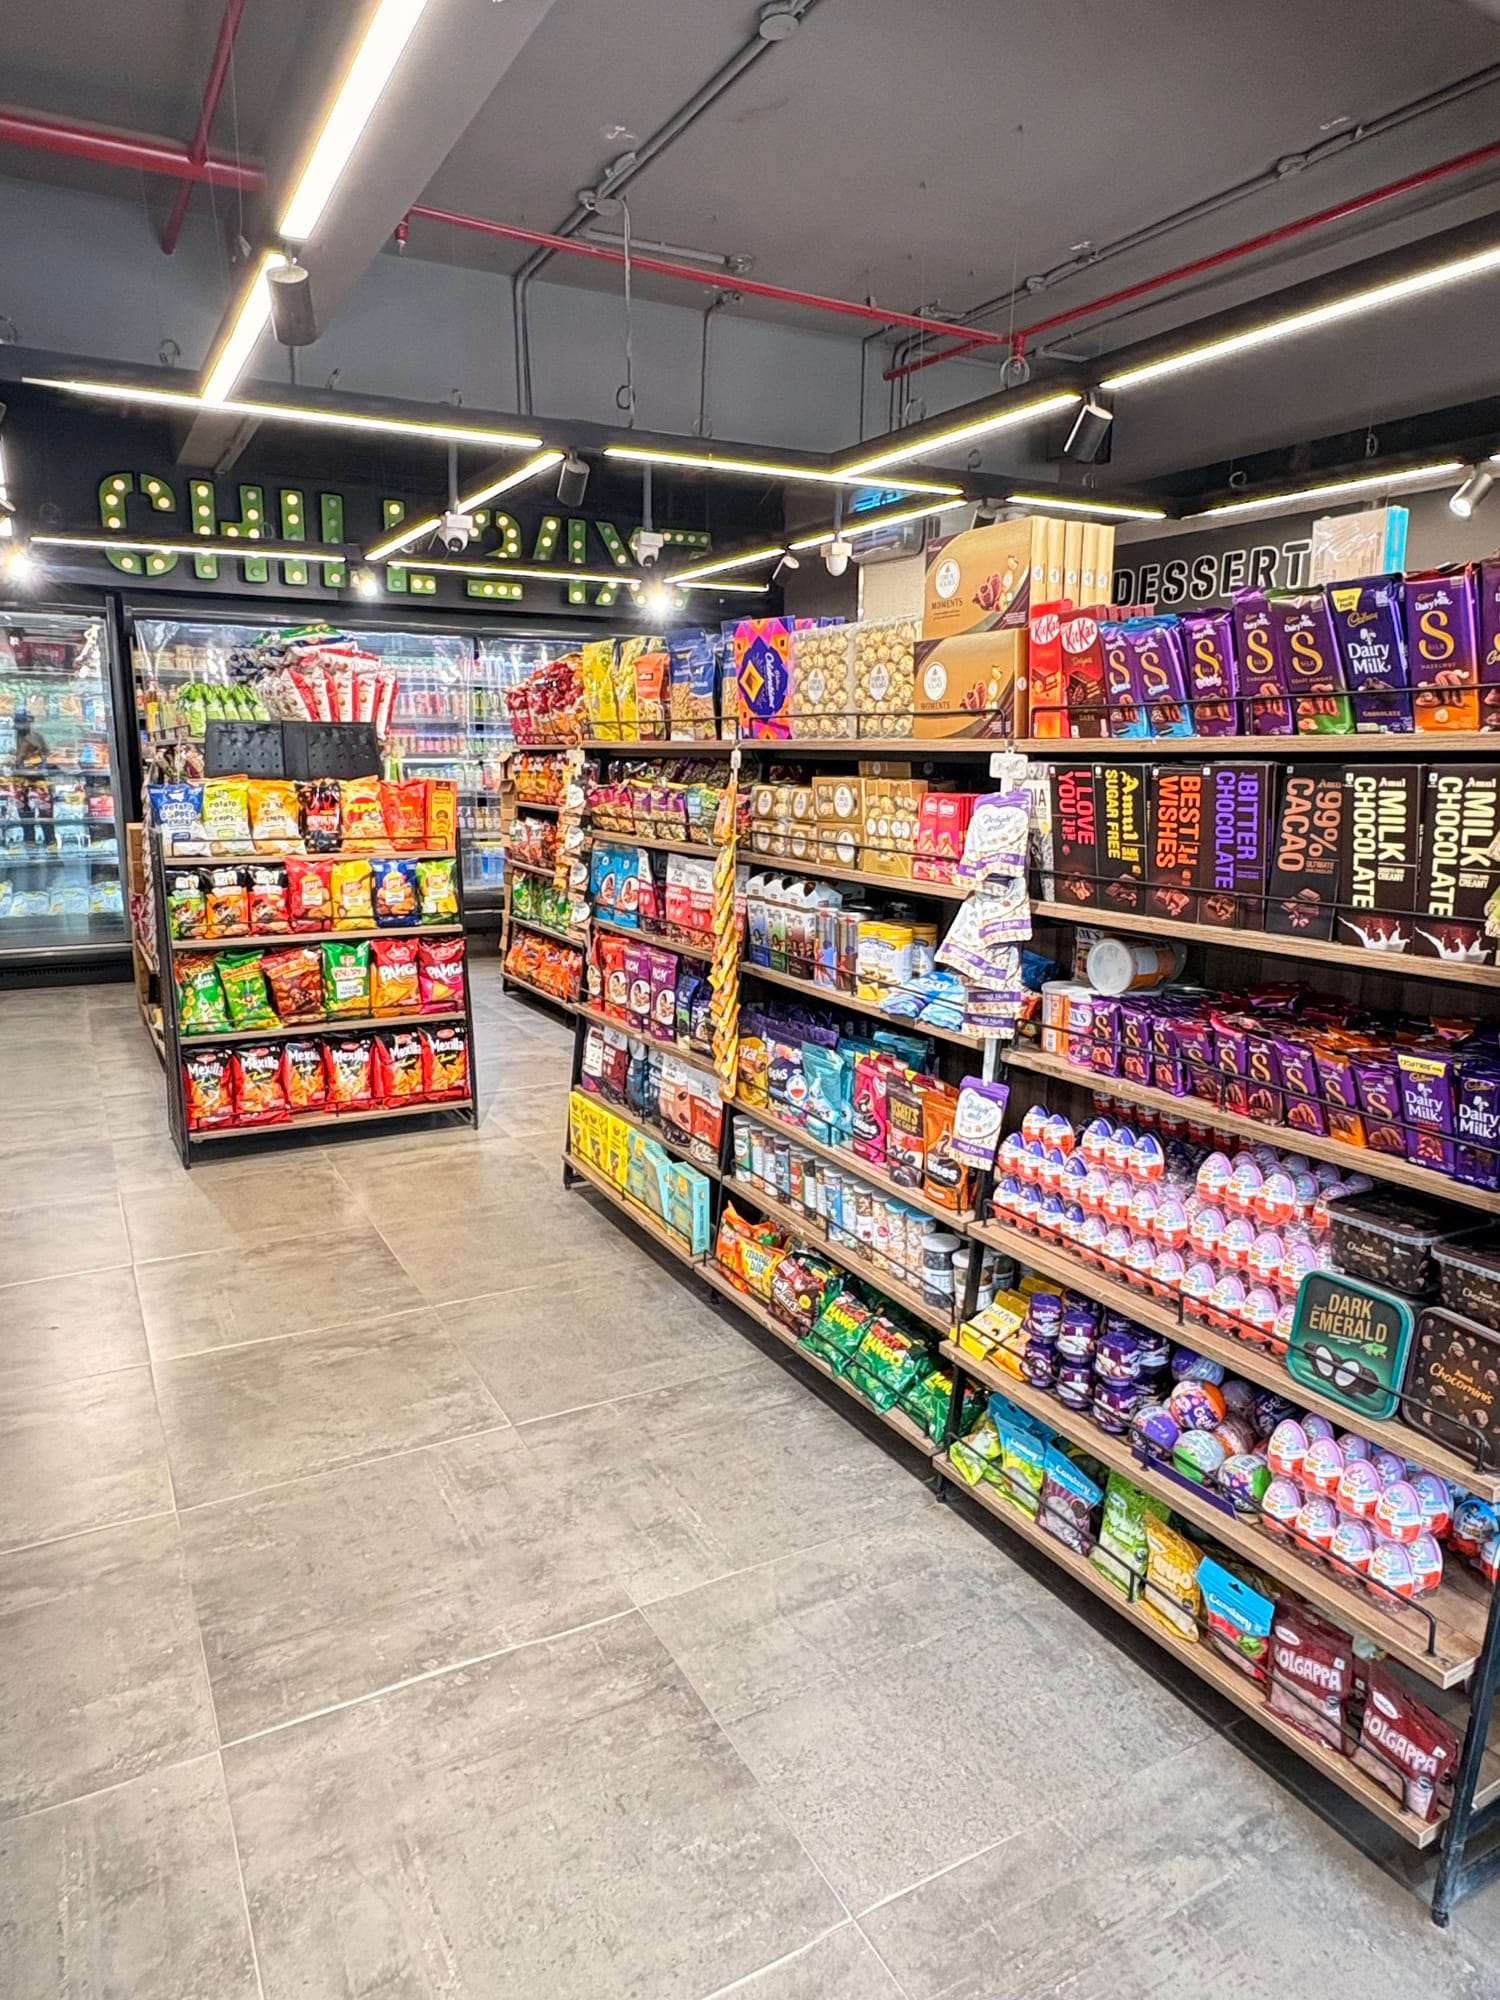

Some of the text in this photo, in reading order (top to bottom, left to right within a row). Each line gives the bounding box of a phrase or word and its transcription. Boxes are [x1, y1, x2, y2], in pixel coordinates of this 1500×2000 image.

[1113, 539, 1312, 606] DESSERT
[931, 598, 963, 609] MOMENTS
[1415, 602, 1433, 611] Dairy
[1063, 619, 1096, 651] KitKat
[1347, 643, 1390, 660] Dairy
[1353, 659, 1391, 675] Milk
[921, 701, 950, 710] MOMENTS
[1058, 771, 1077, 814] YOU
[1378, 777, 1406, 788] Amul
[1466, 777, 1496, 788] Amul
[164, 803, 194, 811] POTATO
[1076, 787, 1095, 845] LOVE
[1105, 769, 1121, 859] SUGAR FREE
[1120, 770, 1140, 840] Amul
[1179, 776, 1201, 840] BEST
[1156, 775, 1179, 868] WISHES
[1215, 771, 1236, 889] CHOCOLATE
[1237, 781, 1258, 860] BITTER
[1277, 777, 1315, 871] CACAO
[1308, 791, 1342, 857] 99%
[1378, 790, 1407, 861] MILK
[1459, 791, 1497, 868] MILK
[1352, 776, 1377, 908] CHOCOLATE
[1428, 776, 1463, 917] CHOCOLATE
[1459, 879, 1489, 889] CREAMY
[332, 1047, 370, 1063] Mexilla
[390, 1041, 423, 1060] Mexilla
[431, 1037, 464, 1054] Mexilla
[187, 1062, 223, 1080] Mexilla
[242, 1056, 279, 1073] Mexilla
[1405, 1090, 1443, 1112] Dairy
[1408, 1104, 1443, 1123] Milk
[1459, 1103, 1499, 1127] Dairy
[1460, 1118, 1497, 1140] Milk
[1346, 1241, 1388, 1263] Chocominis
[825, 1304, 860, 1331] MANGO
[1328, 1293, 1374, 1320] DARK
[1309, 1309, 1388, 1343] EMERALD
[863, 1331, 904, 1367] MANGO
[1429, 1362, 1495, 1405] Chocominis
